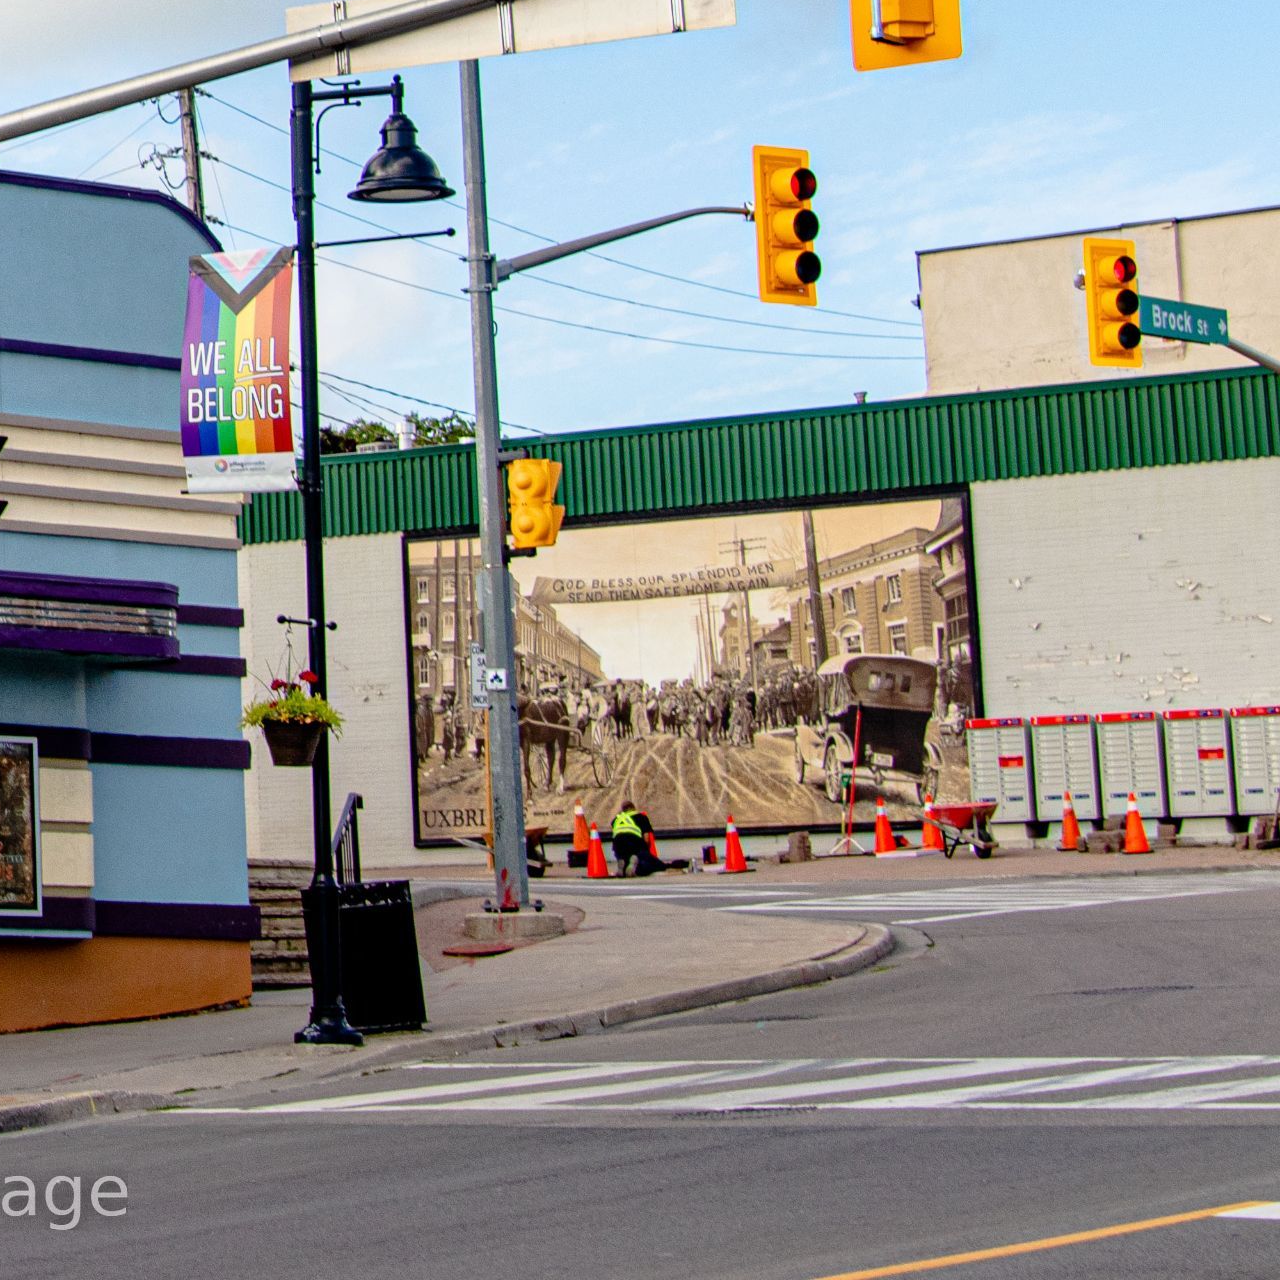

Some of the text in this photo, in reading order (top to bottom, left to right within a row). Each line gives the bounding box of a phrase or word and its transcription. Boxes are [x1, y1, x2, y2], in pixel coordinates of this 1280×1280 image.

[1151, 304, 1193, 334] Brock
[189, 337, 282, 376] WE ALL
[187, 383, 284, 423] BELONG
[552, 562, 775, 594] GOD BLESS OUR SPLENDID MEN
[567, 577, 769, 604] SEND THEM SAFE HOME AGAIN
